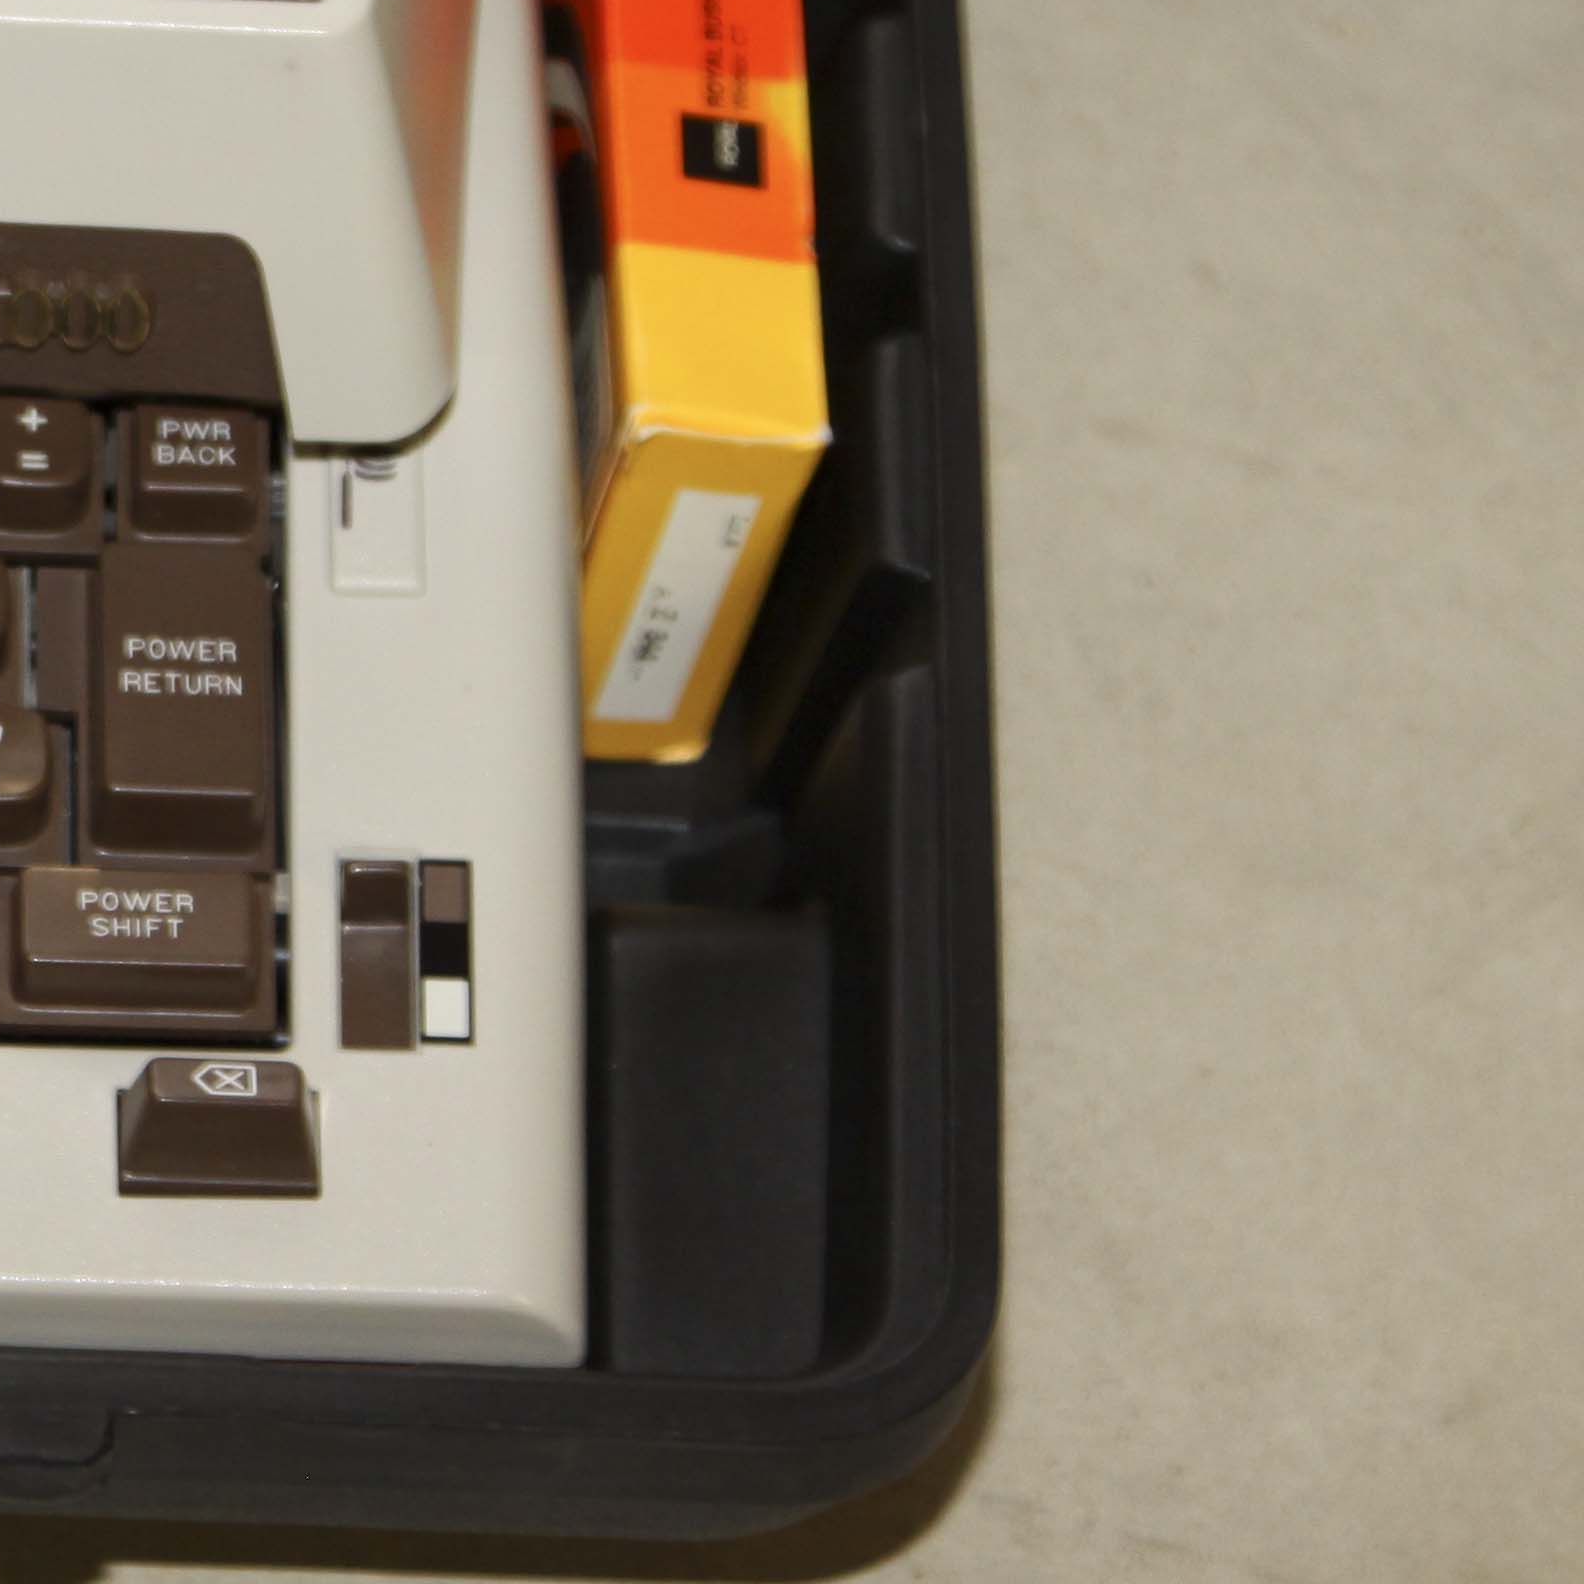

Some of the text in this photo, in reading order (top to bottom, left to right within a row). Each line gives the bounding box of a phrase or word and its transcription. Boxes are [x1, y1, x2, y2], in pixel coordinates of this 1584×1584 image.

[19, 407, 48, 433] +
[159, 419, 232, 441] PWR
[155, 443, 235, 466] BACK
[124, 636, 238, 663] POWER
[119, 669, 244, 696] RETURN
[78, 889, 195, 914] POWER
[90, 915, 184, 939] SHIFT
